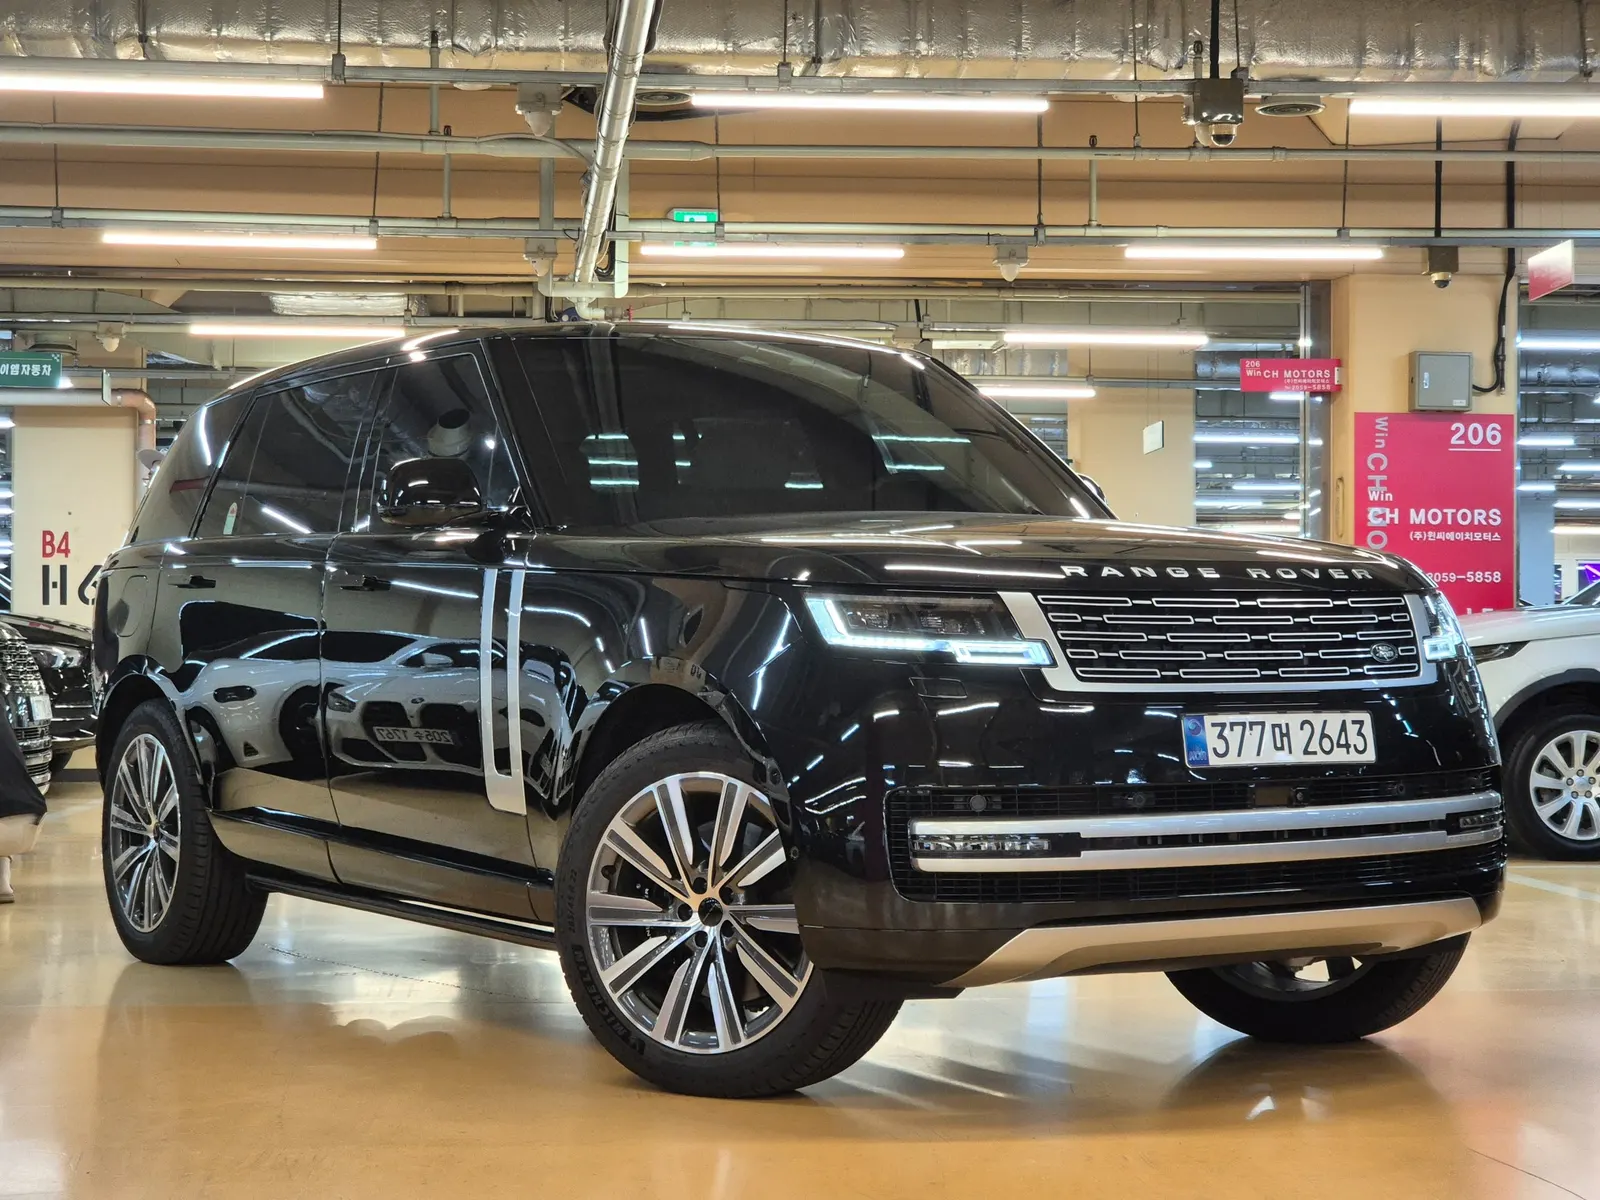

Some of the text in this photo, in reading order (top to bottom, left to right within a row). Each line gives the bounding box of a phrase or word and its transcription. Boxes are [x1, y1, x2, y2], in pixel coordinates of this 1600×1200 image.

[1284, 370, 1331, 378] MOTORS
[1375, 416, 1388, 448] Win
[1450, 423, 1502, 445] 206
[1367, 453, 1388, 491] CH
[1368, 490, 1393, 501] Win
[1368, 508, 1502, 525] CH MOTORS
[42, 530, 70, 558] B4
[1060, 565, 1373, 580] RANGE ROVER
[1211, 719, 1368, 758] 377머 2643
